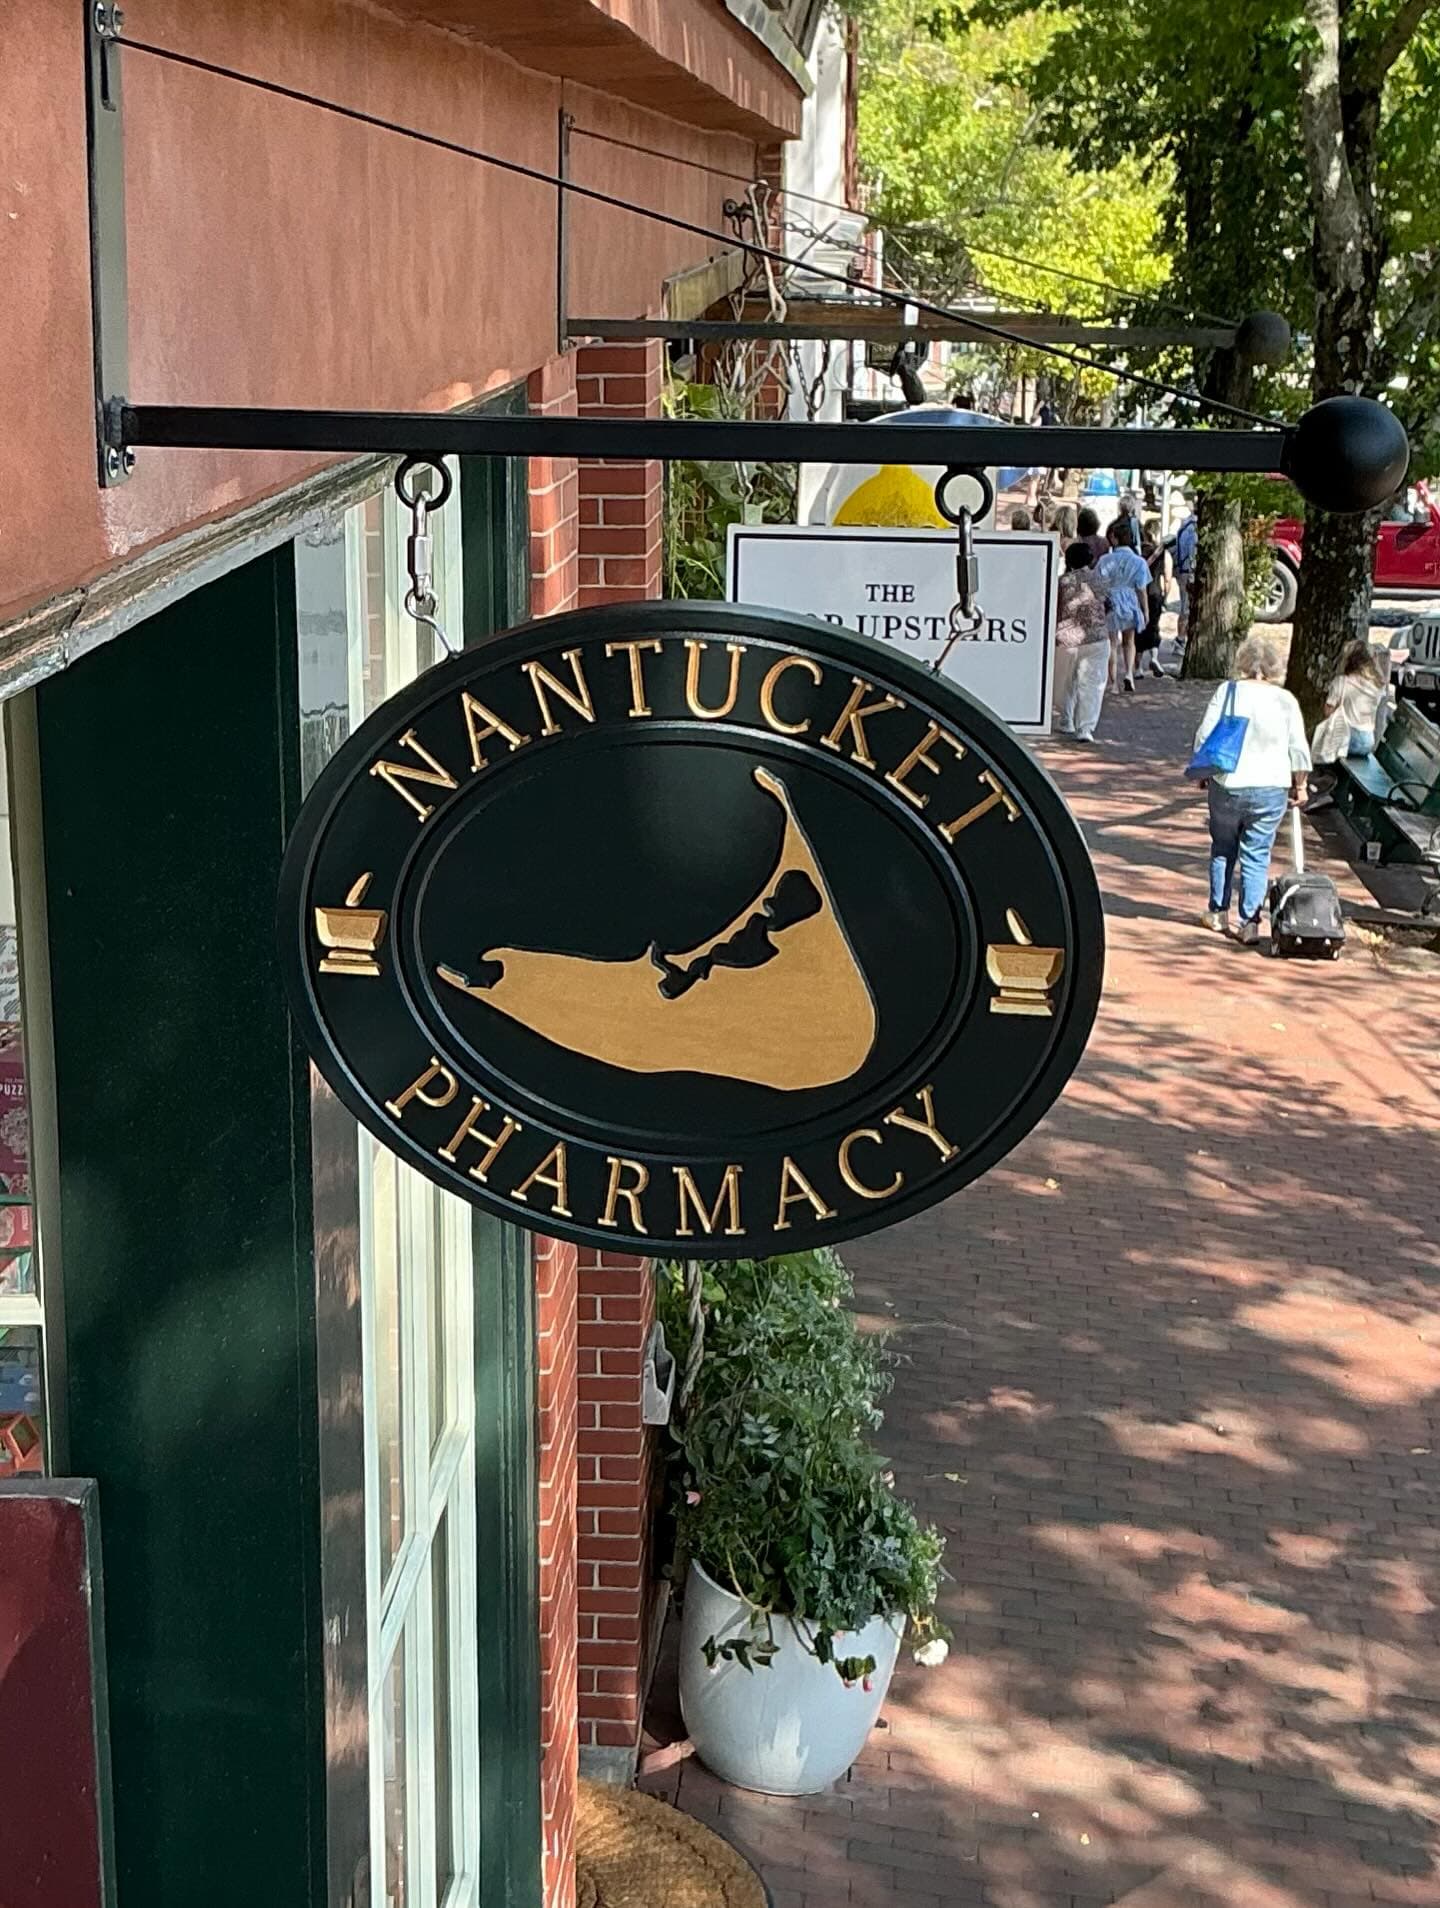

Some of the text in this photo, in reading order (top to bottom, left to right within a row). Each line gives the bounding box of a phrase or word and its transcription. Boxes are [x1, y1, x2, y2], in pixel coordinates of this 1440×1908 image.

[865, 583, 915, 603] THE
[369, 638, 1020, 845] NANTUCKET
[385, 1056, 961, 1236] PHARMACY
